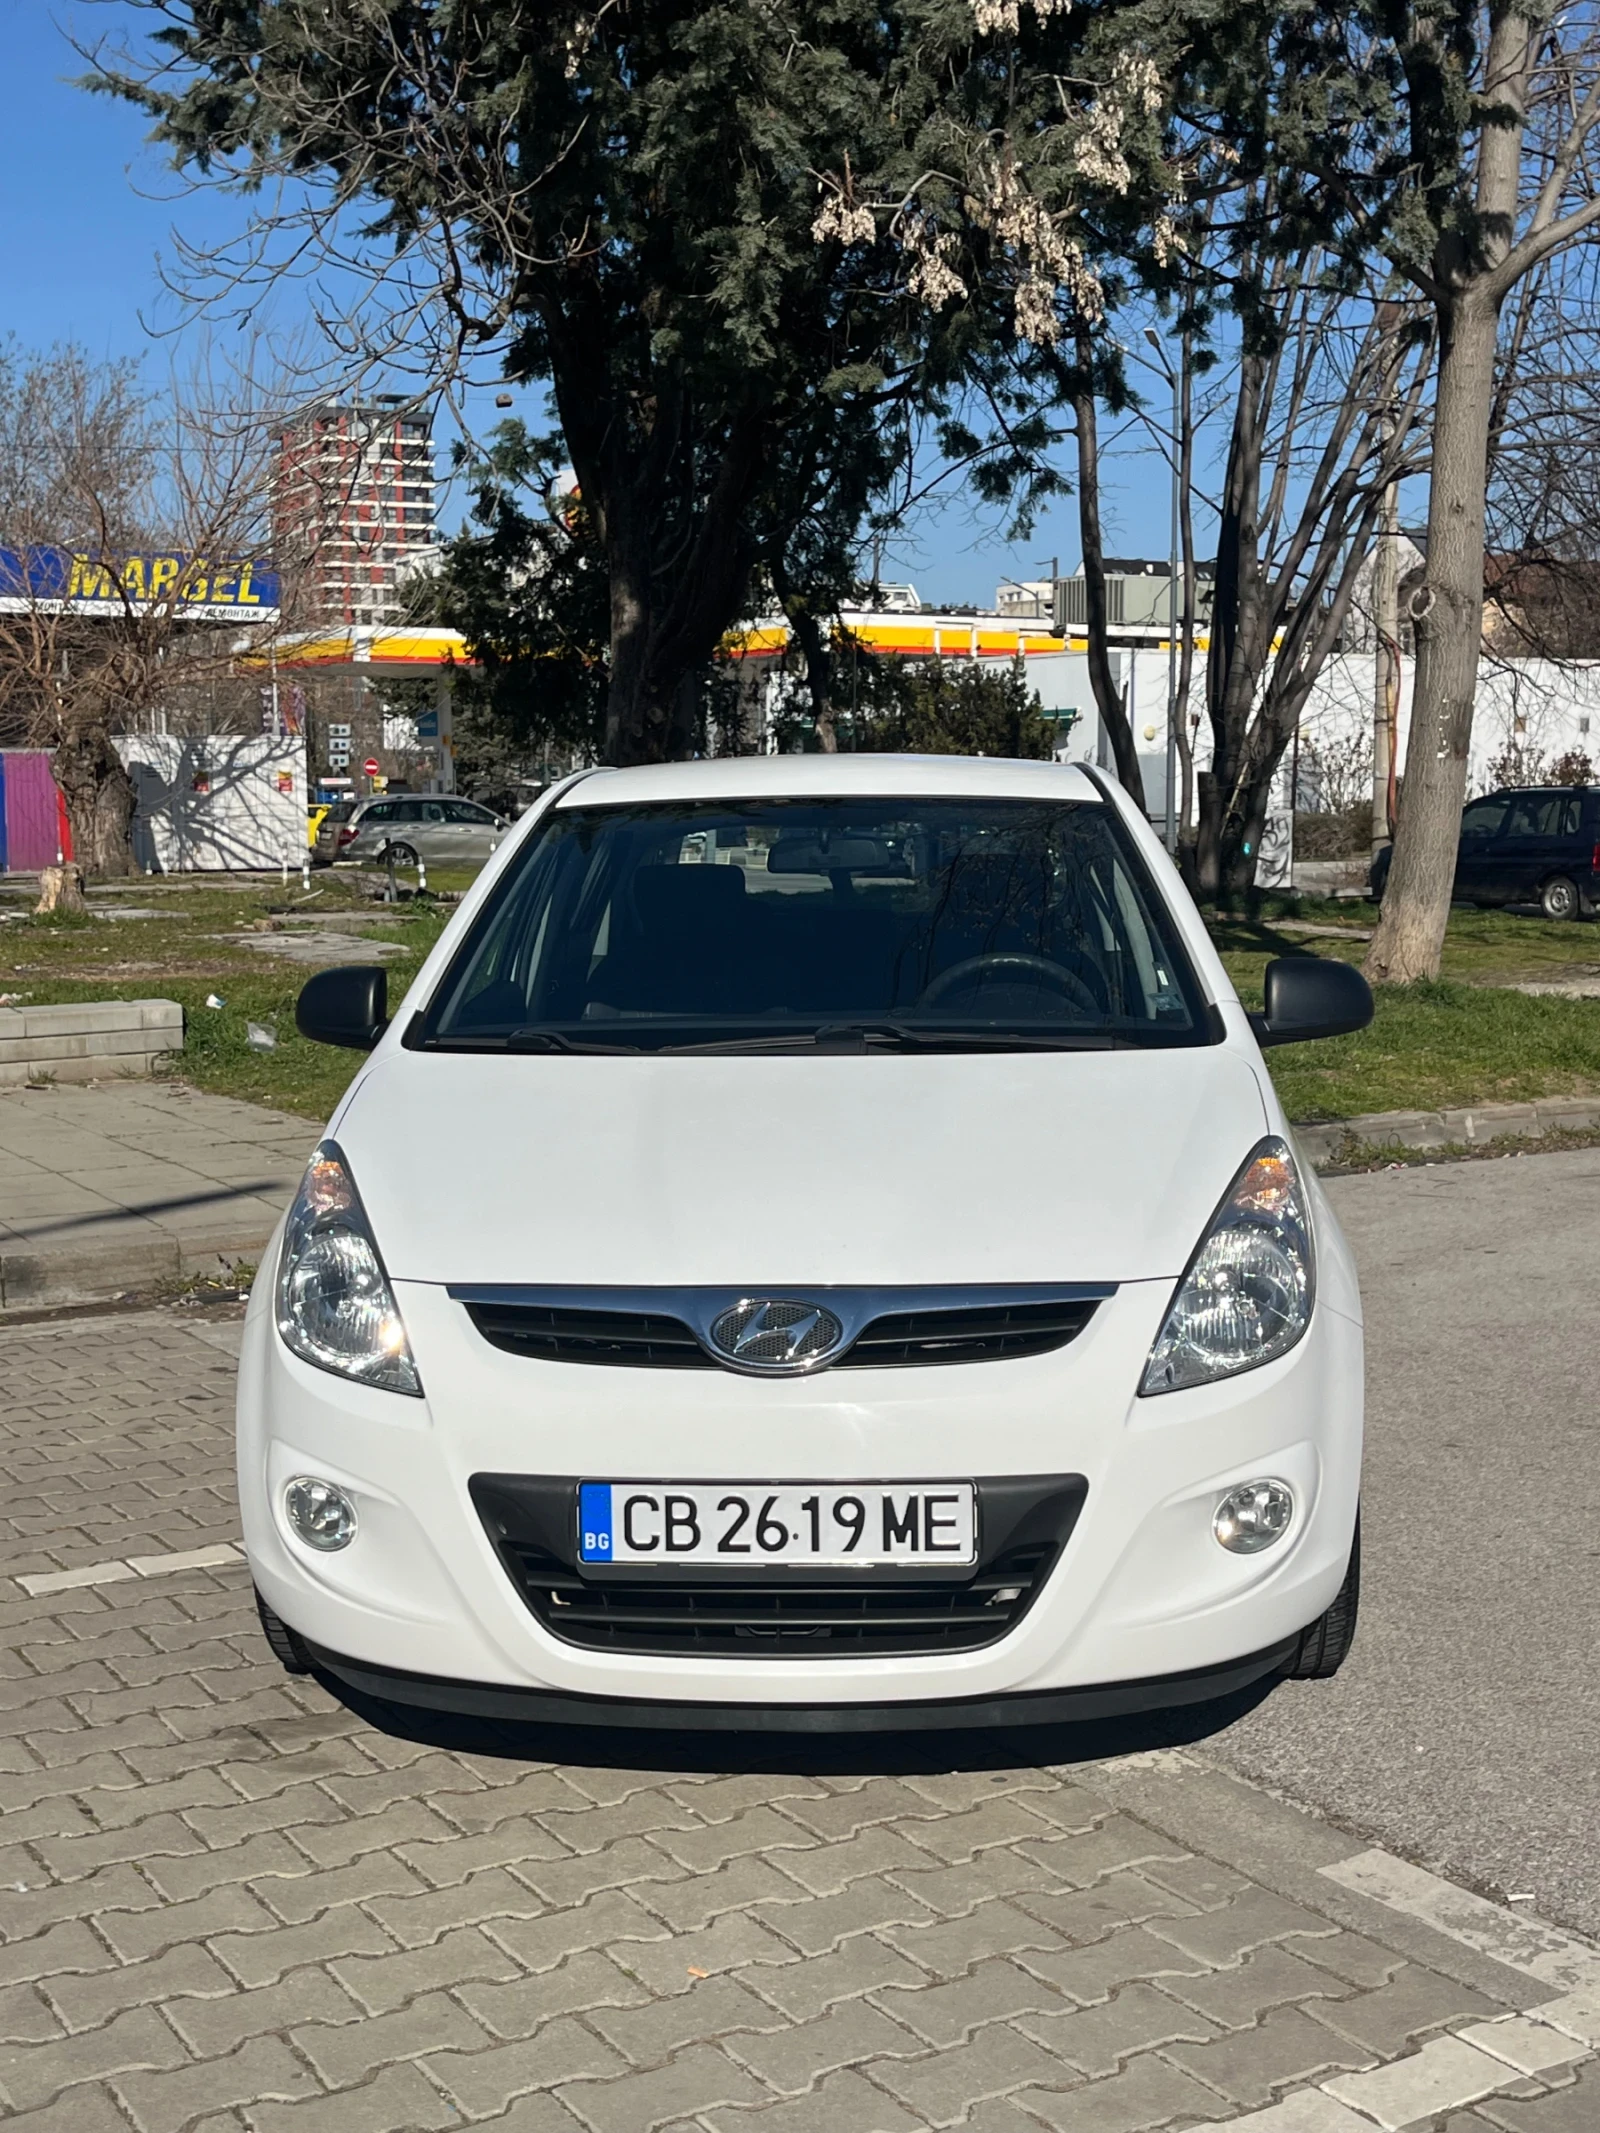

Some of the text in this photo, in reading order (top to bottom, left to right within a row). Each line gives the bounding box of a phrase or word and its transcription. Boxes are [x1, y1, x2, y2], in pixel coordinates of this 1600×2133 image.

[584, 1532, 610, 1550] BG
[624, 1494, 701, 1552] CB
[882, 1494, 962, 1552] ME
